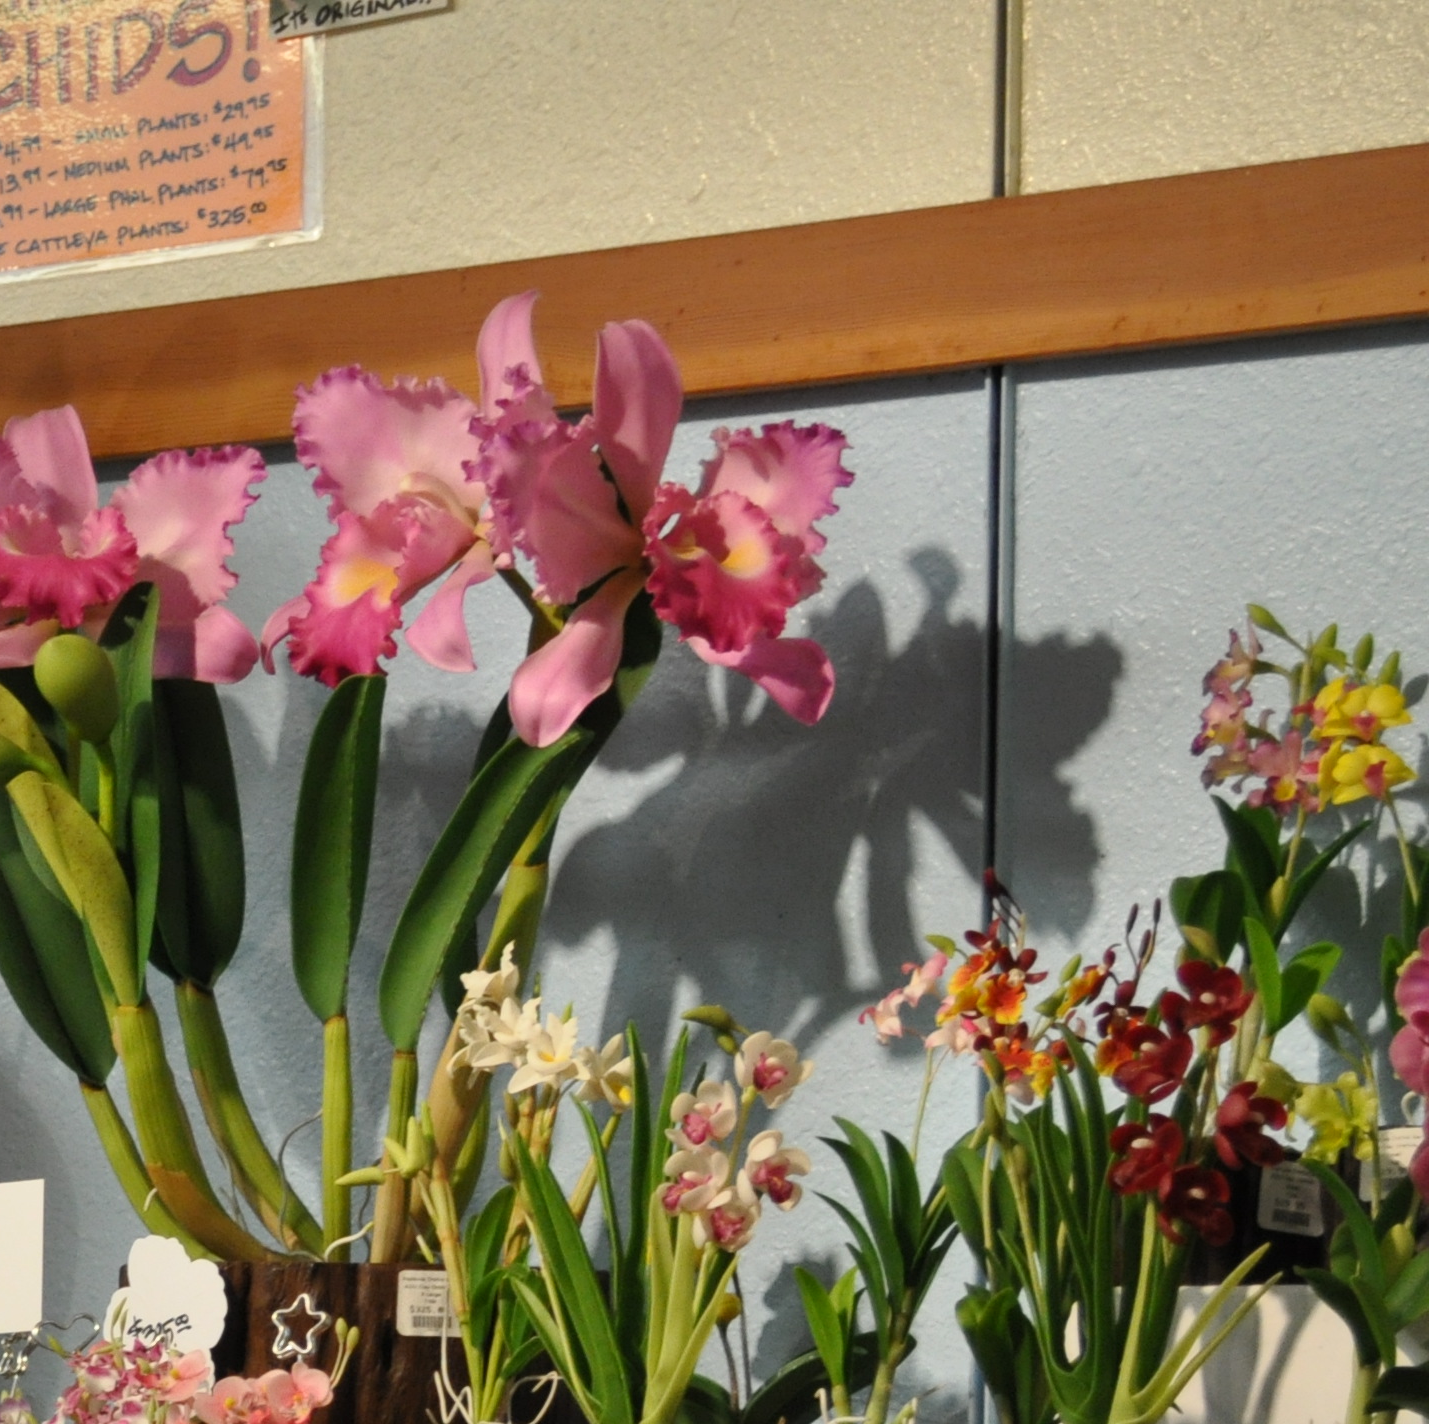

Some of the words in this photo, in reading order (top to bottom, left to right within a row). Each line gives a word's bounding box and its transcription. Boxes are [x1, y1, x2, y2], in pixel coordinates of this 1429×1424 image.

[137, 111, 209, 136] PLANTS:
[64, 158, 132, 182] MEDIUM
[138, 141, 211, 171] PLANTS:
[211, 124, 276, 153] $49.95
[43, 195, 98, 219] LARGE
[157, 176, 226, 206] PLANTS:
[229, 157, 289, 189] $79.95
[13, 229, 109, 256] CATTLEYA
[117, 221, 190, 247] PLANTS:
